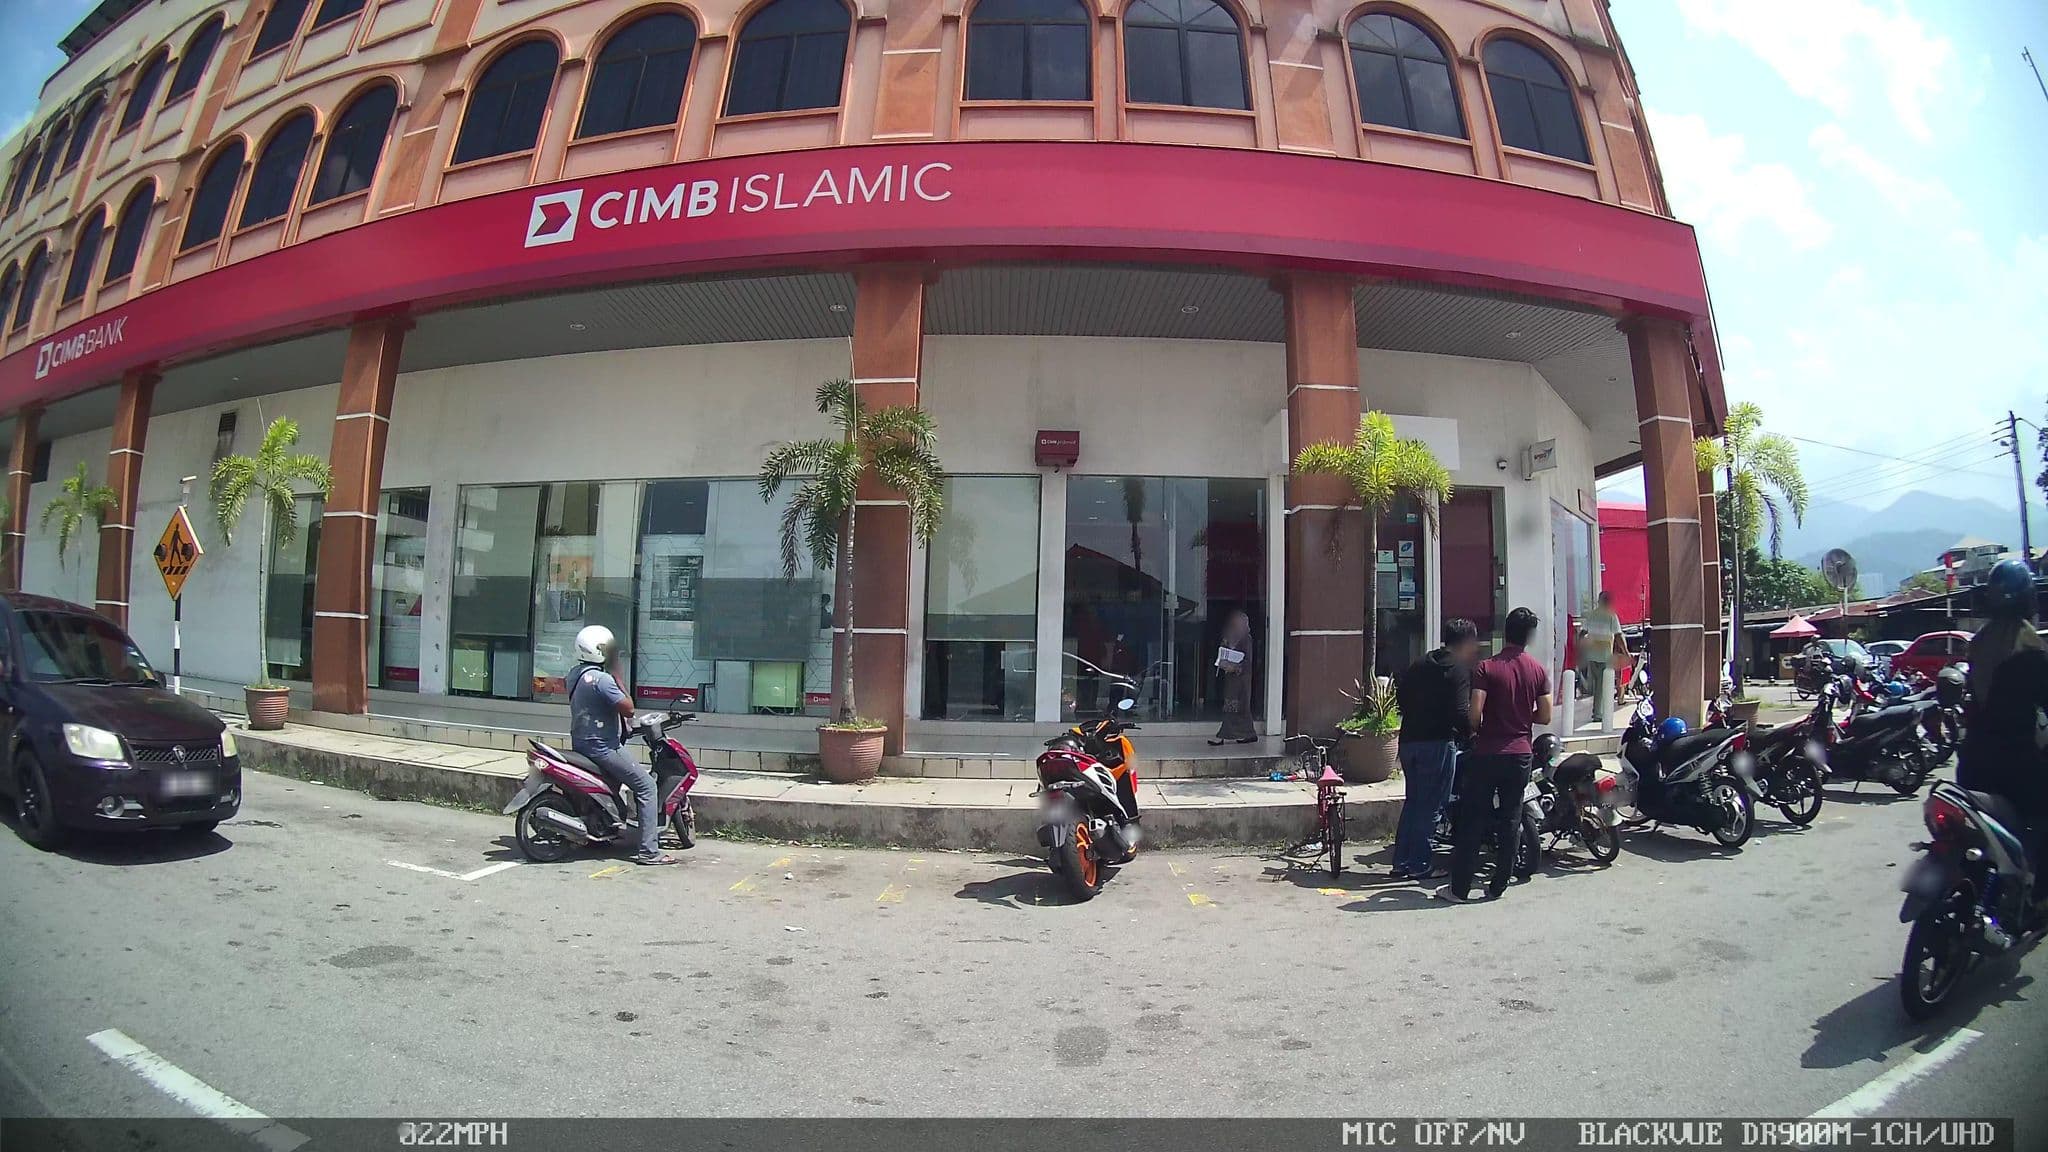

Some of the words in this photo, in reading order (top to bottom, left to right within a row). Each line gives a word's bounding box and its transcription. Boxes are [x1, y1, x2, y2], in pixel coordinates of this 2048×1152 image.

[590, 179, 719, 229] CIMB
[728, 162, 953, 213] ISLAMIC
[51, 333, 86, 368] CIMB
[85, 316, 128, 355] BANK
